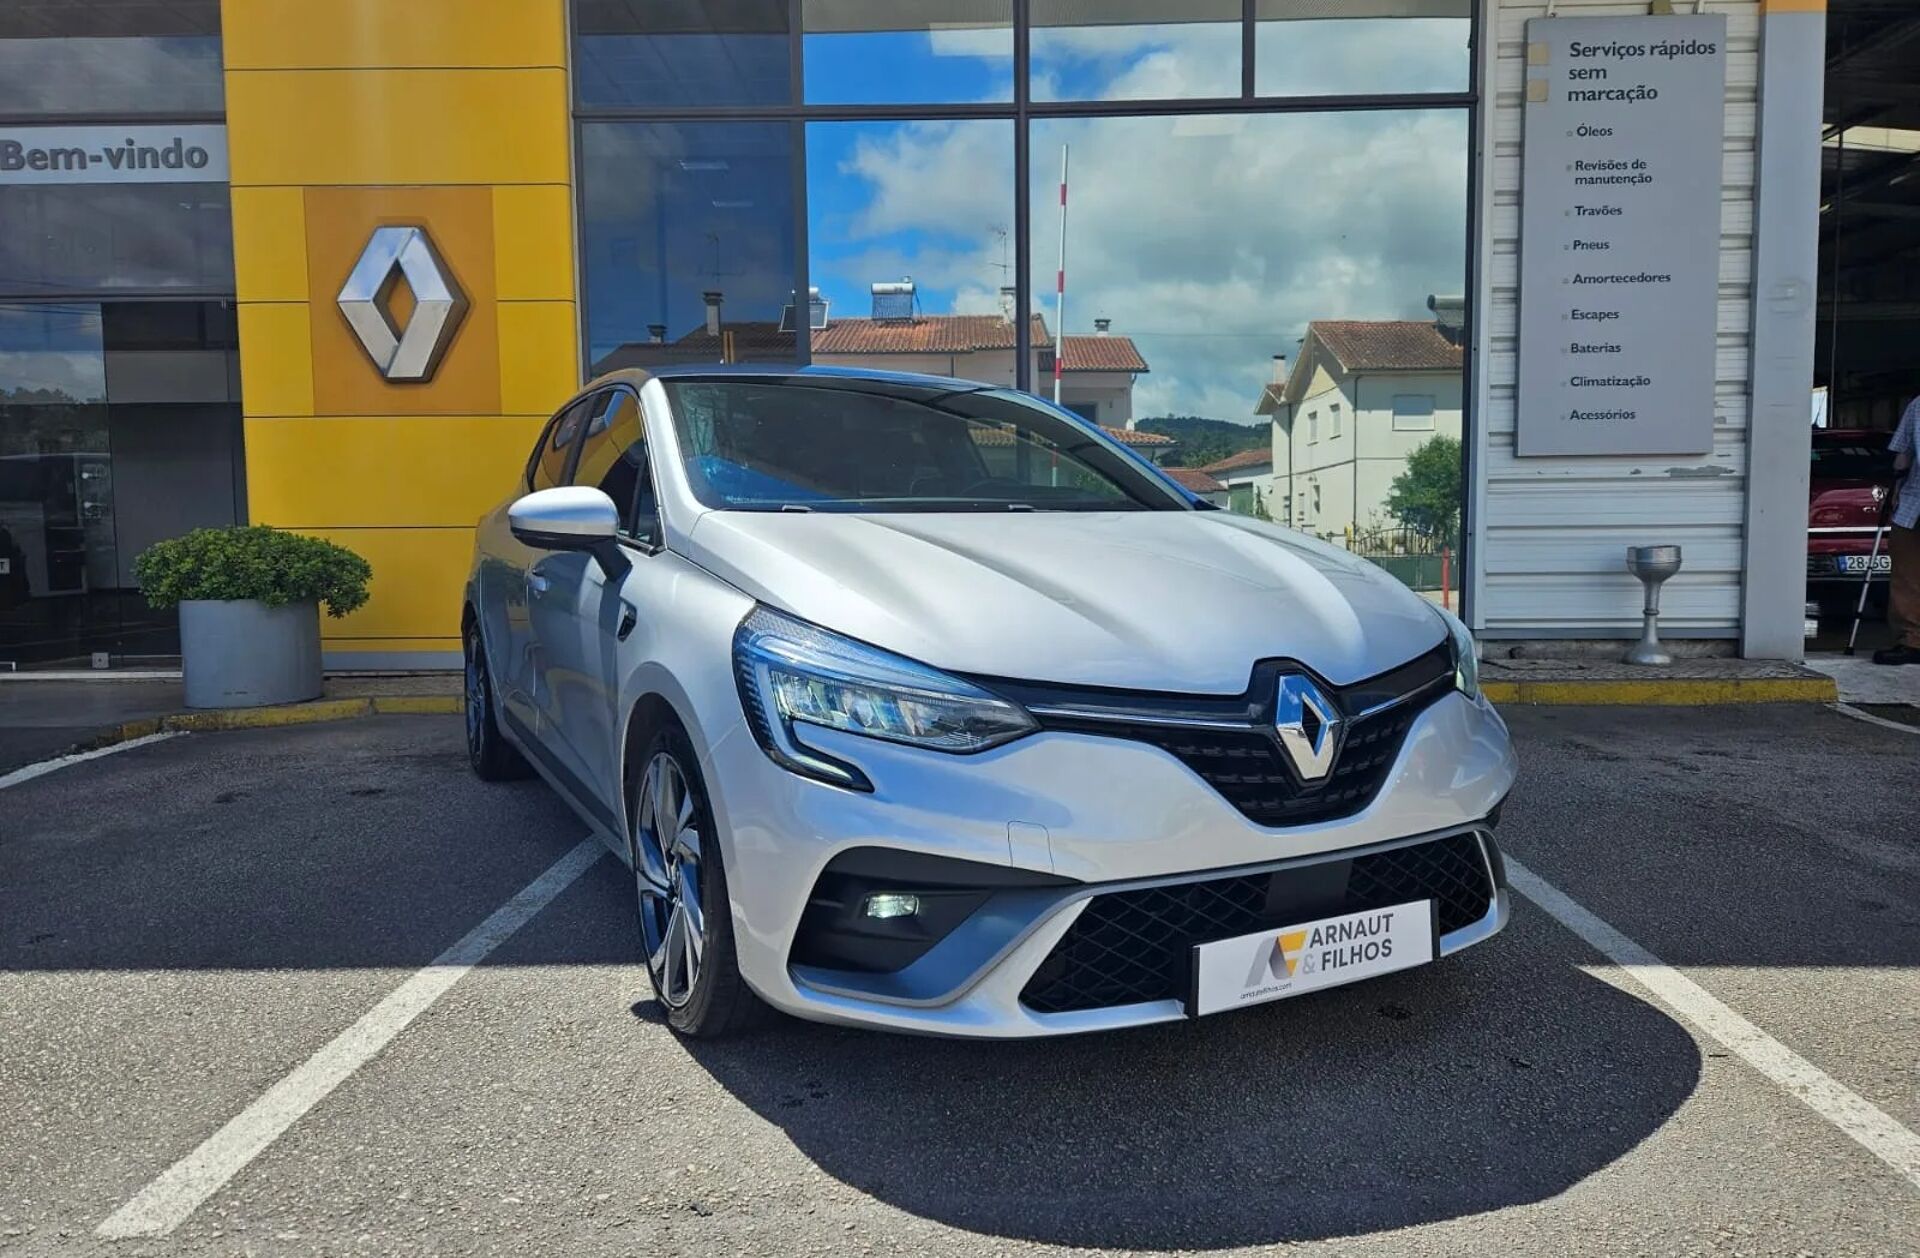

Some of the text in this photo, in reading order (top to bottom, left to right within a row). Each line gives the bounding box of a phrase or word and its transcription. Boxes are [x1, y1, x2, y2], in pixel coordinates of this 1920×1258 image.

[1570, 39, 1716, 60] Serviços rápidos
[1568, 67, 1607, 80] sem
[1568, 85, 1658, 104] marcação
[1577, 123, 1613, 137] Óleos
[0, 137, 208, 170] Bem-vindo
[1575, 159, 1647, 171] Revisões de
[1575, 173, 1652, 186] manutenção
[1575, 205, 1622, 217] Travões
[1573, 240, 1610, 250] Pneus
[1572, 272, 1671, 285] Amortecedores
[1571, 309, 1619, 322] Escapes
[1571, 342, 1621, 353] Baterias
[1571, 376, 1650, 388] Climatização
[1570, 408, 1636, 420] Acessórios
[1309, 913, 1394, 948] ARNAUT
[1302, 938, 1392, 975] & FILHOS
